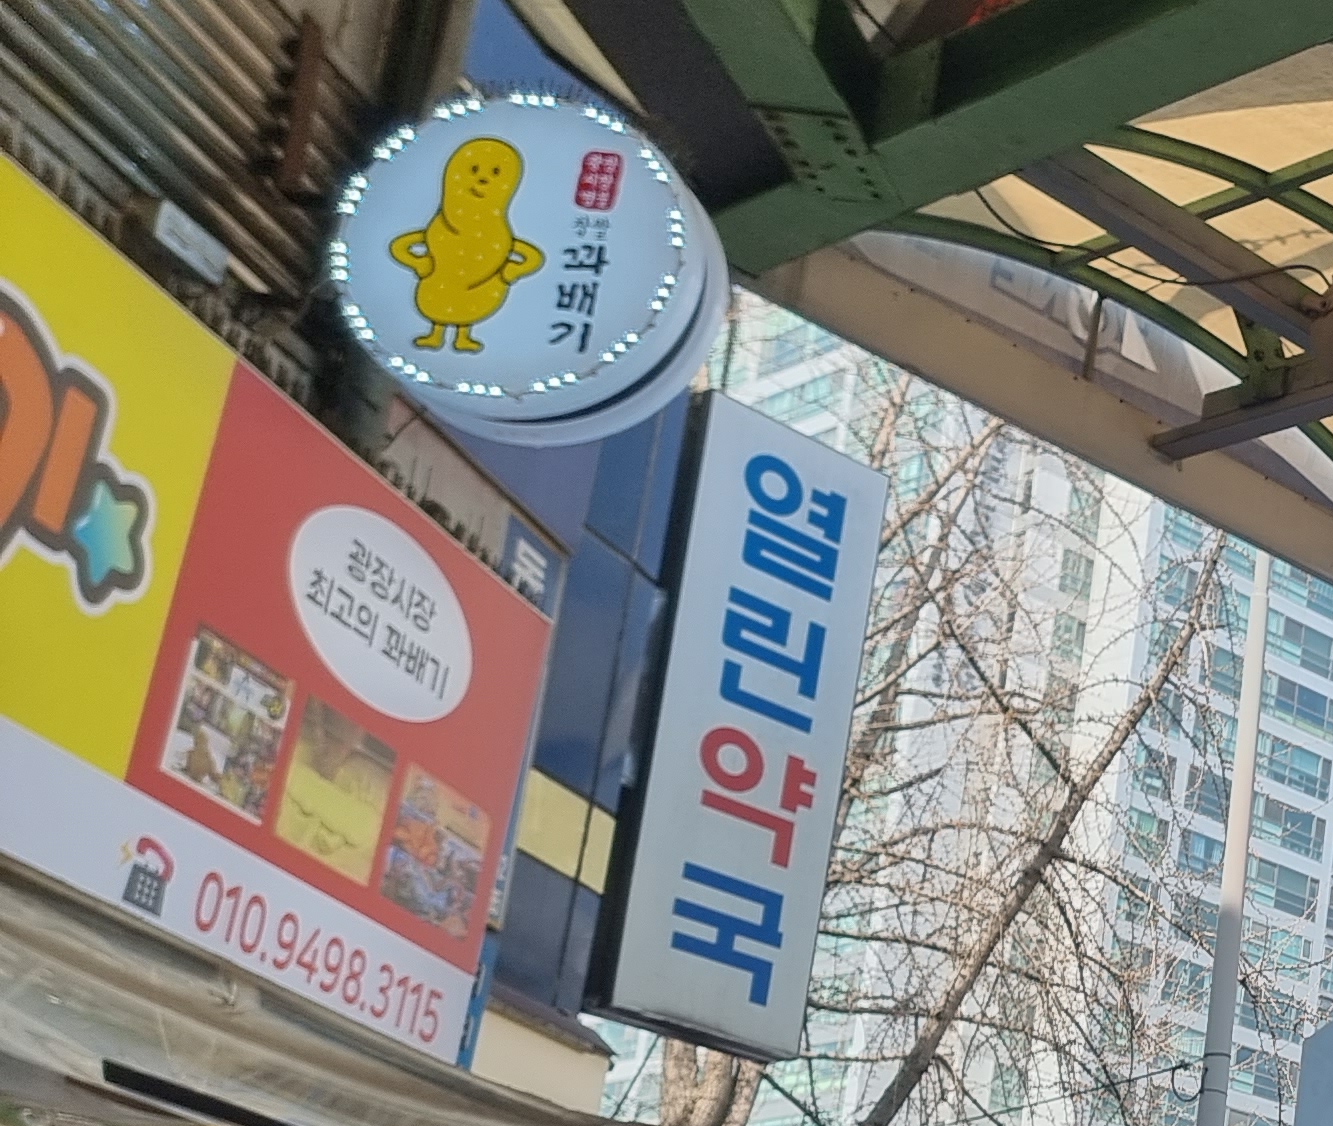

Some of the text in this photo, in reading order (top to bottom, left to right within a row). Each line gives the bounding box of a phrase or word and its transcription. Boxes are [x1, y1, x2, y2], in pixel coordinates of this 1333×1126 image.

[306, 567, 449, 700] 최고의 꽈배기
[347, 537, 437, 633] 광장시장
[671, 453, 847, 1007] 열린약국
[194, 871, 447, 1044] 010.9498.3115
